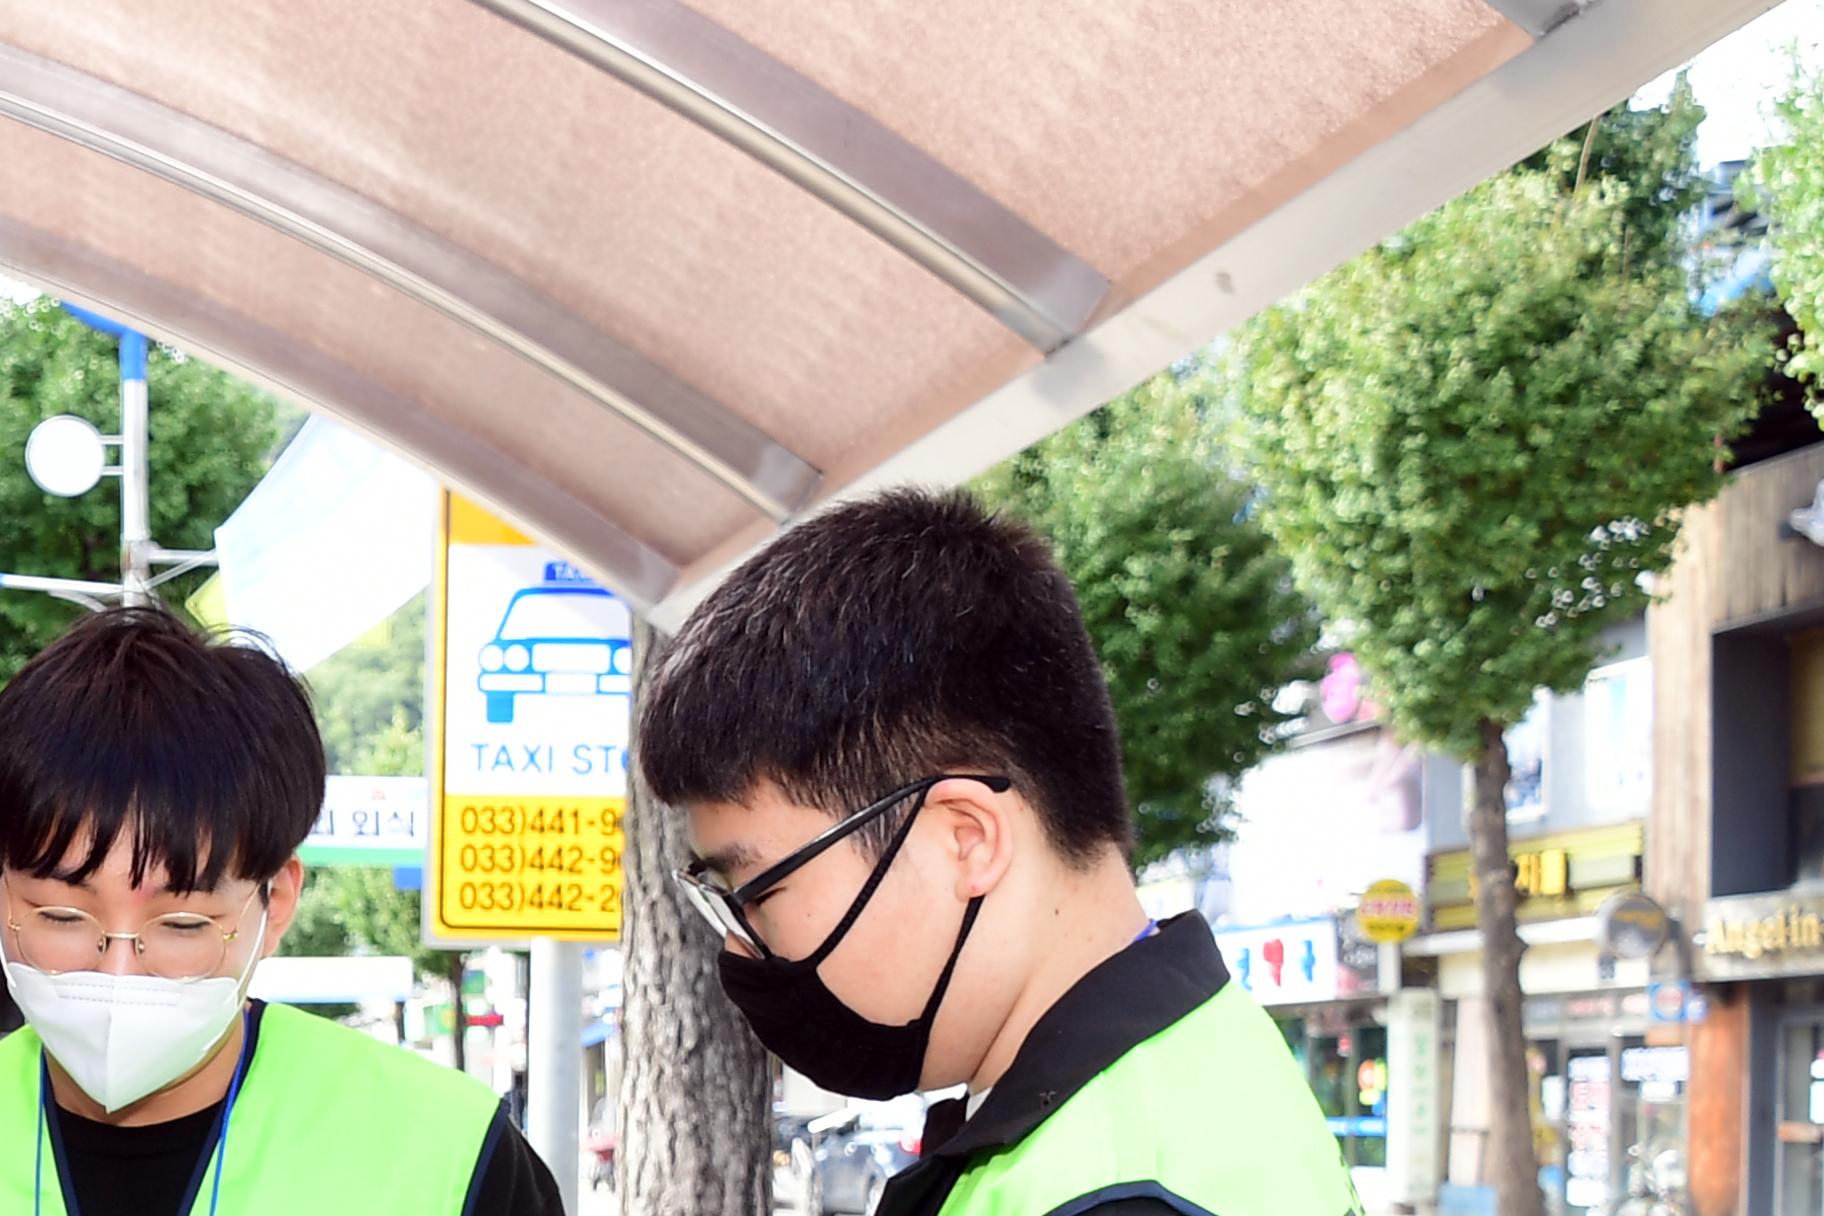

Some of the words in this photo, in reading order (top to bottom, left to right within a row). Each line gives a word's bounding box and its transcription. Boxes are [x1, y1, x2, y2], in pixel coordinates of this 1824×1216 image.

[471, 744, 554, 772] TAXI
[351, 809, 414, 836] 외식
[460, 806, 624, 837] 033)441-9
[460, 844, 622, 875] 033)442-9
[459, 881, 619, 912] 033)442-2
